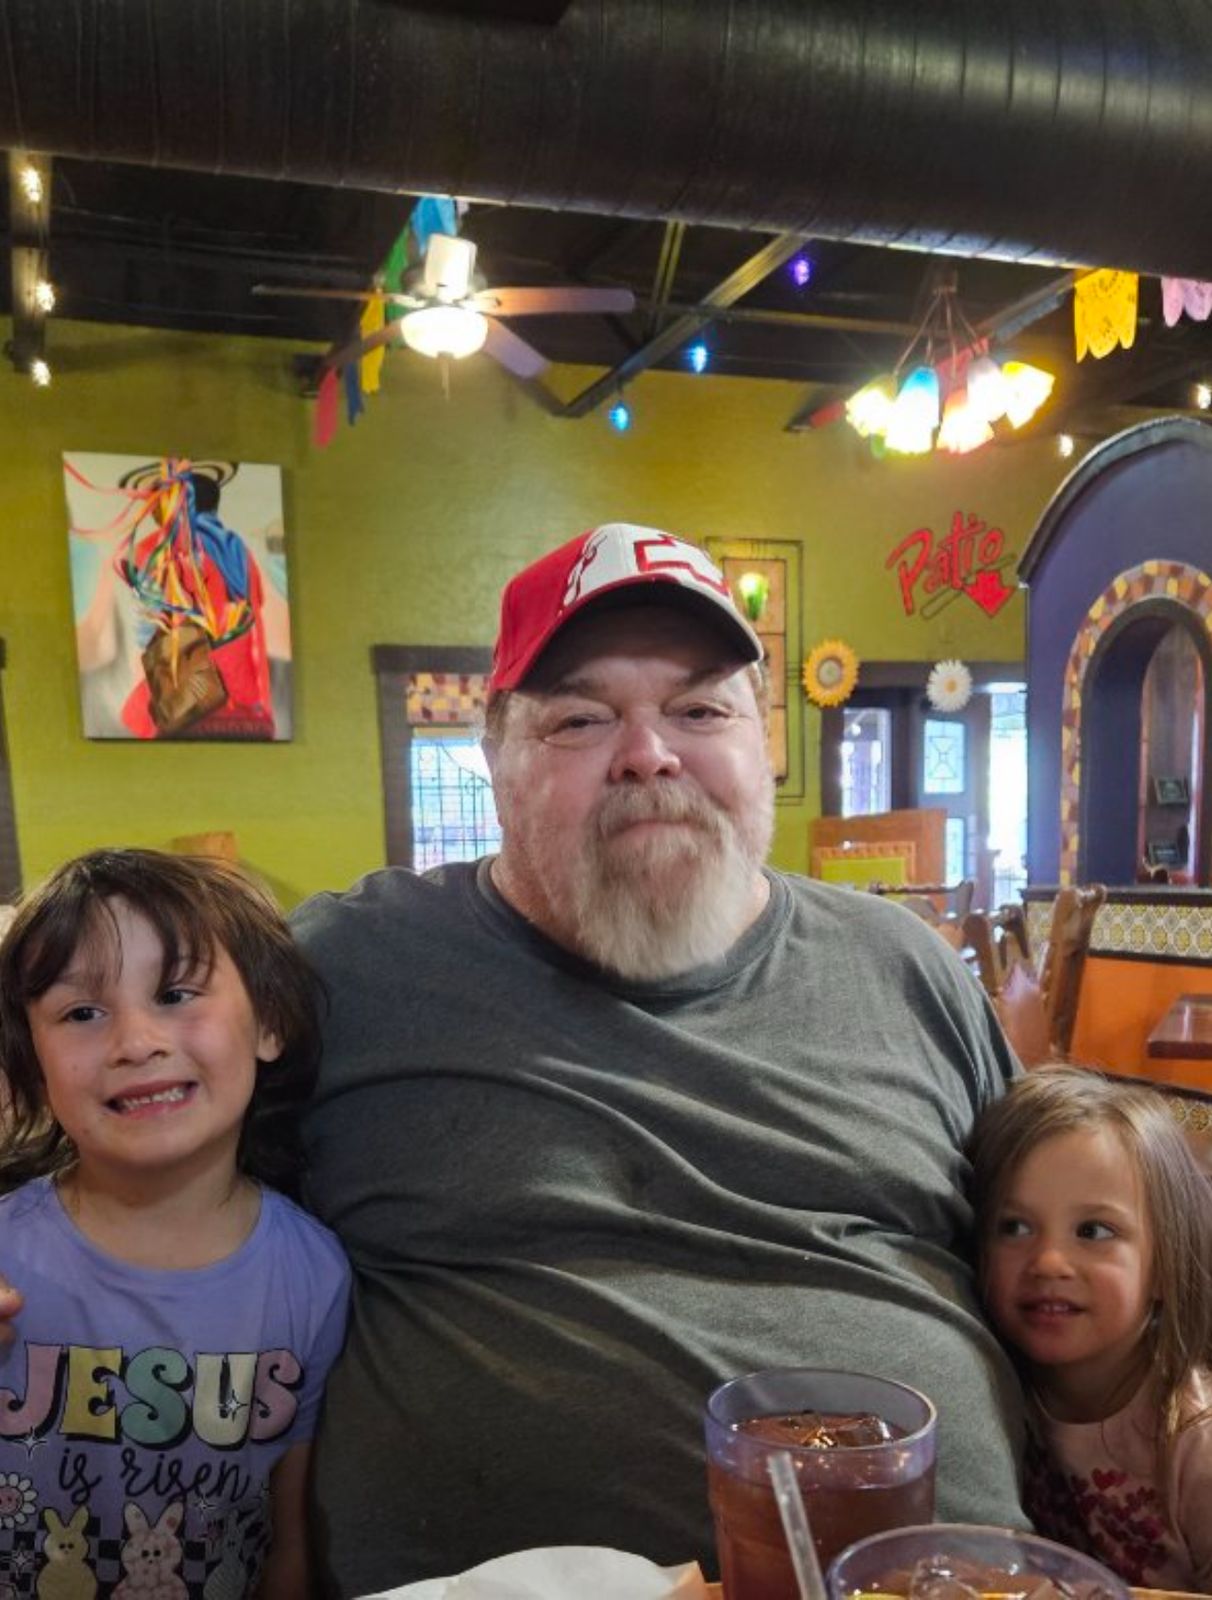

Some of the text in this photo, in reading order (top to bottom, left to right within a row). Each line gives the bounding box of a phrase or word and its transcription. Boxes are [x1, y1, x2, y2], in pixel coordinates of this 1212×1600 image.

[885, 511, 1004, 616] Patio
[0, 1342, 304, 1450] JESUS
[58, 1448, 251, 1505] is risen
